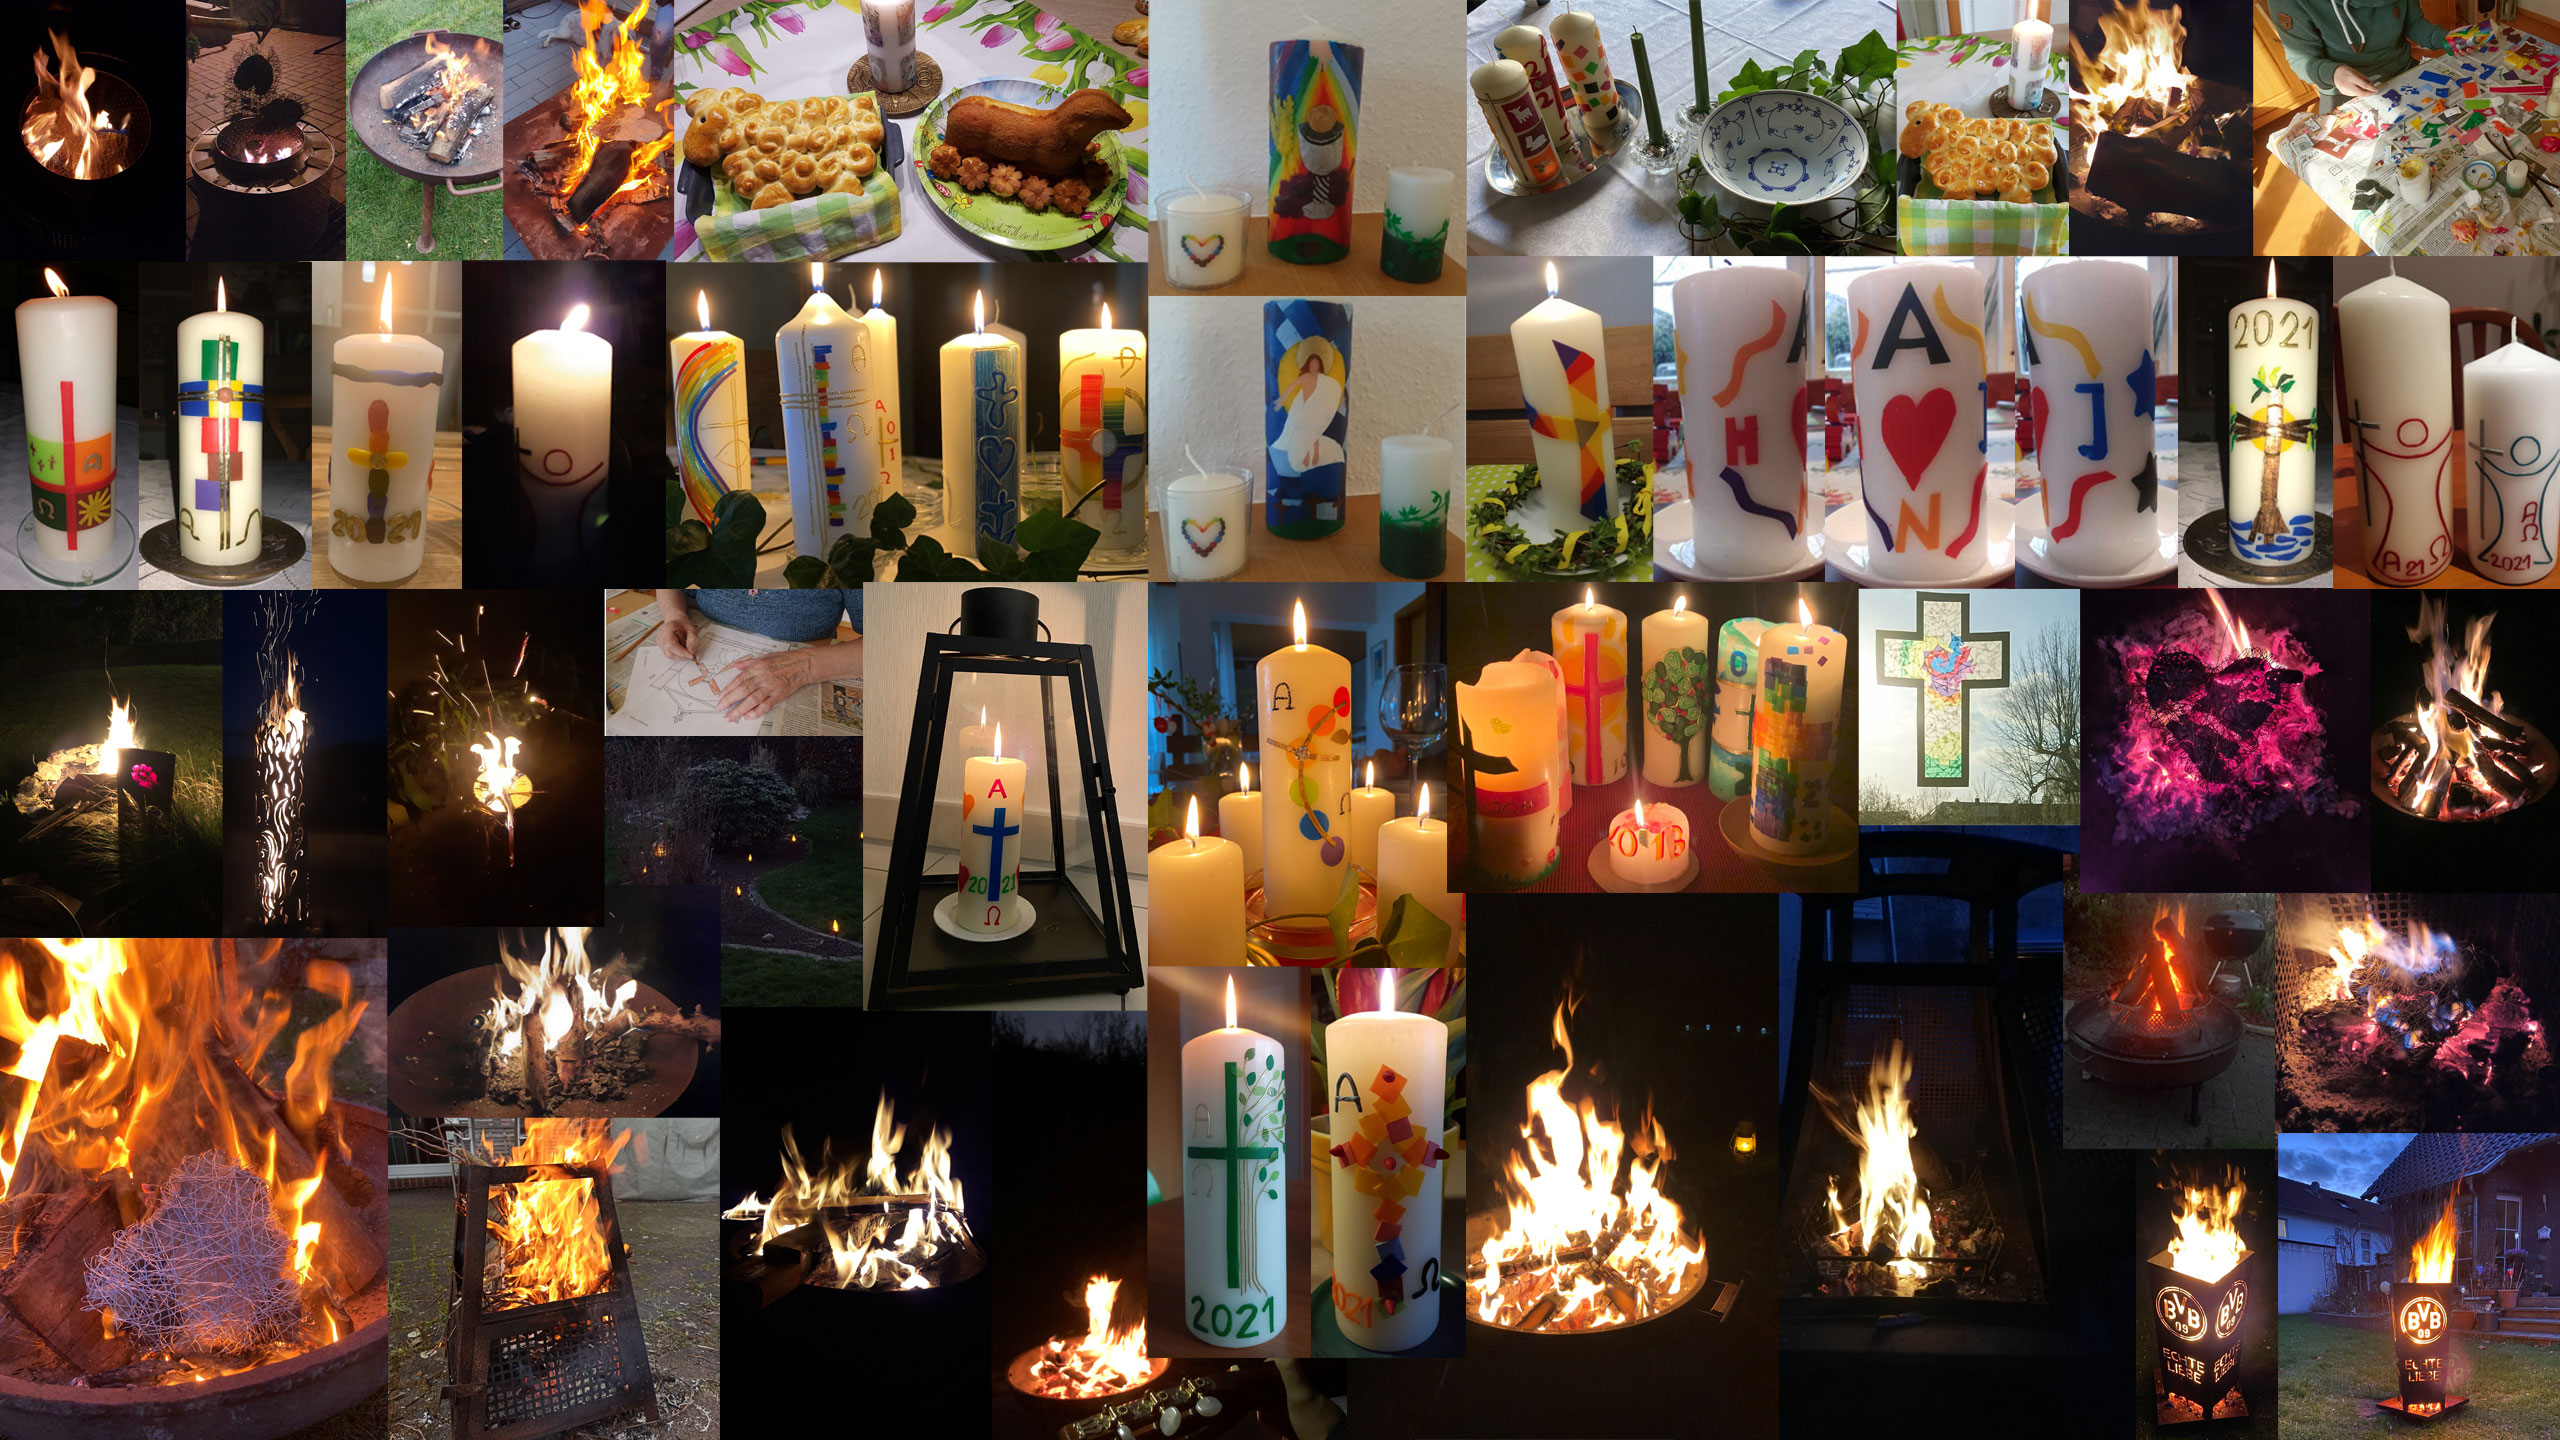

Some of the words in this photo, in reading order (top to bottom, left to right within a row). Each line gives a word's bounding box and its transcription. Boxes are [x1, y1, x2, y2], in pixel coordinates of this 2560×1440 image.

[1872, 281, 1951, 369] A
[2234, 309, 2313, 350] 2021
[875, 400, 886, 413] A
[2075, 383, 2108, 461] J
[1725, 415, 1759, 466] H
[332, 509, 366, 544] 20
[387, 509, 422, 545] 21
[1895, 492, 1941, 553] N
[2521, 501, 2538, 525] A
[2405, 559, 2425, 576] 21
[2490, 554, 2531, 571] 2021
[1272, 682, 1295, 711] A
[987, 778, 1007, 799] A
[968, 876, 988, 895] 20
[1001, 873, 1017, 894] 21
[1335, 1072, 1362, 1113] A
[1192, 1104, 1213, 1139] A
[1190, 1295, 1275, 1339] 2021
[2164, 1293, 2200, 1329] BVB
[2220, 1287, 2244, 1327] BVB
[2407, 1303, 2441, 1330] BVB
[2175, 1321, 2188, 1334] 09
[2418, 1329, 2431, 1338] 09
[2163, 1347, 2205, 1374] ECHTE
[2214, 1340, 2240, 1373] ECHTE
[2167, 1361, 2202, 1385] LIEBE
